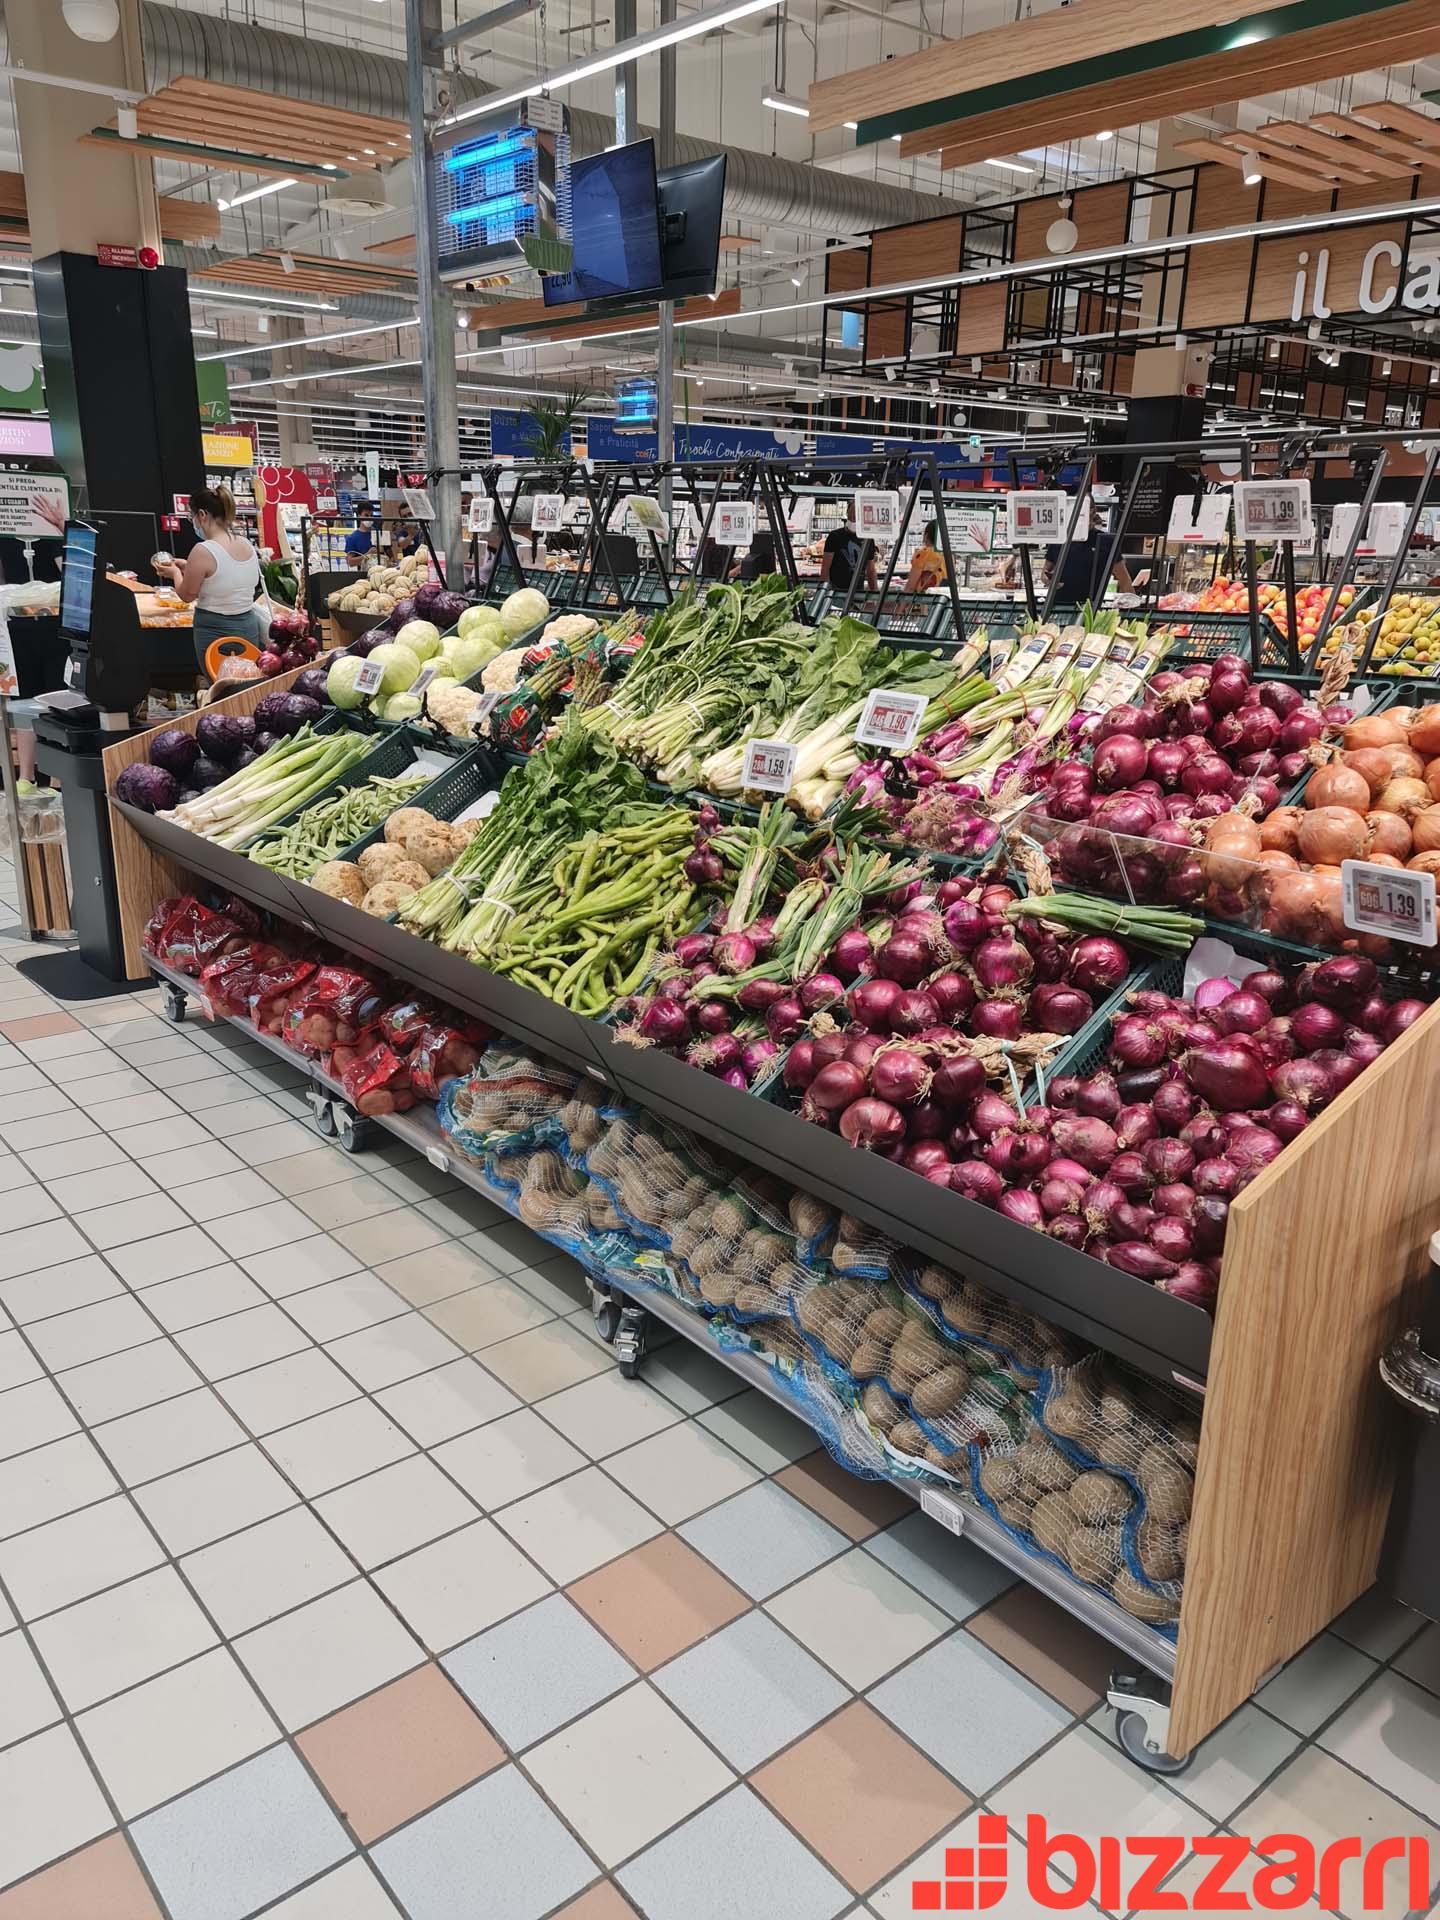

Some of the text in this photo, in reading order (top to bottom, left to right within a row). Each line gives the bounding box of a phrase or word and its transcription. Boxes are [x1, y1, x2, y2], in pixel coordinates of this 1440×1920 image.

[1291, 240, 1440, 322] il Ca
[876, 507, 890, 522] 1.59
[1036, 508, 1053, 524] 1.59
[1271, 500, 1295, 518] 1.99
[733, 515, 744, 529] 1.59
[889, 714, 908, 730] 1.98
[768, 758, 785, 774] 1.59
[1386, 891, 1416, 917] 1.39
